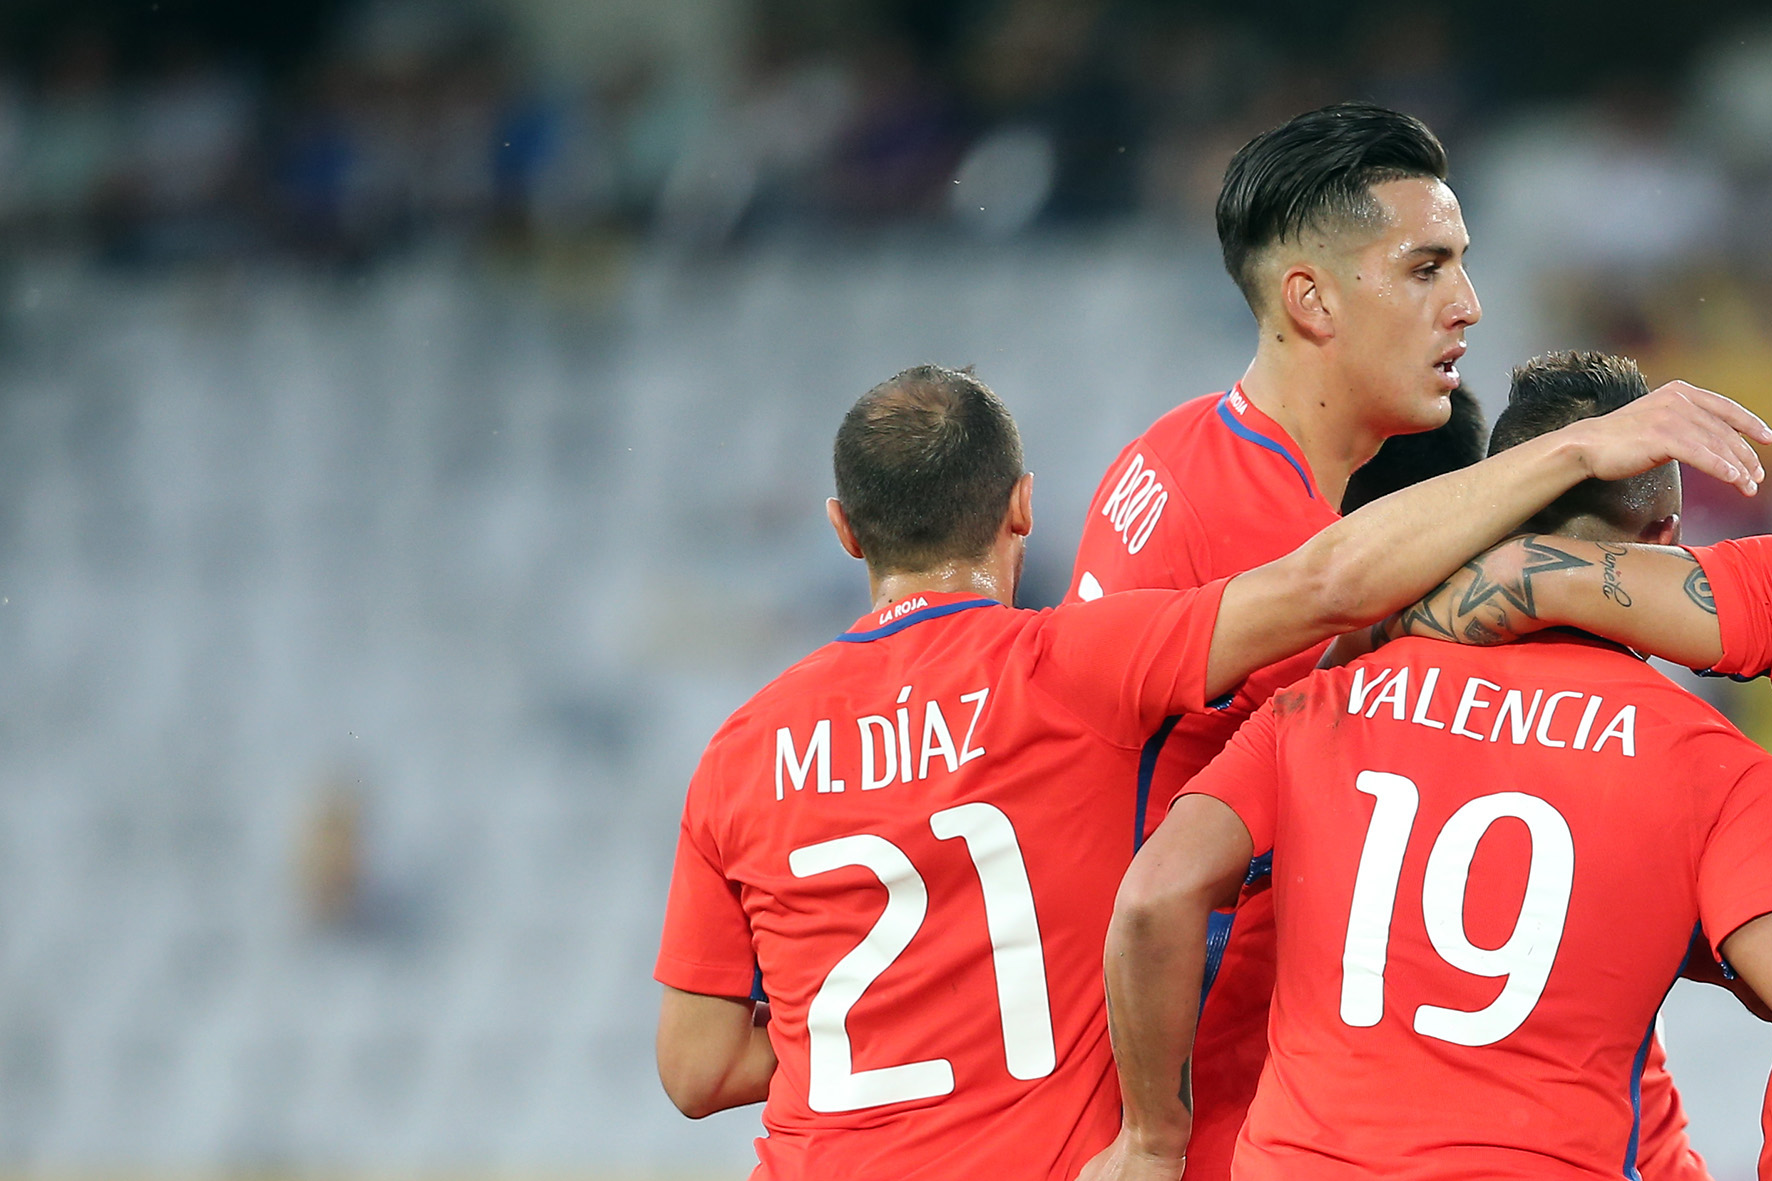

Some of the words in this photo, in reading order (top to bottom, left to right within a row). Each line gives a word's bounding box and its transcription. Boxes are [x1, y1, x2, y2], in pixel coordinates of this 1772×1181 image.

[1102, 453, 1169, 555] ROCO
[879, 609, 894, 625] LA
[894, 596, 929, 618] ROJA
[775, 720, 845, 801] M.
[856, 685, 990, 791] DÍAZ
[1347, 666, 1638, 757] VALENCIA
[788, 802, 1056, 1113] 21
[1340, 770, 1575, 1047] 19
